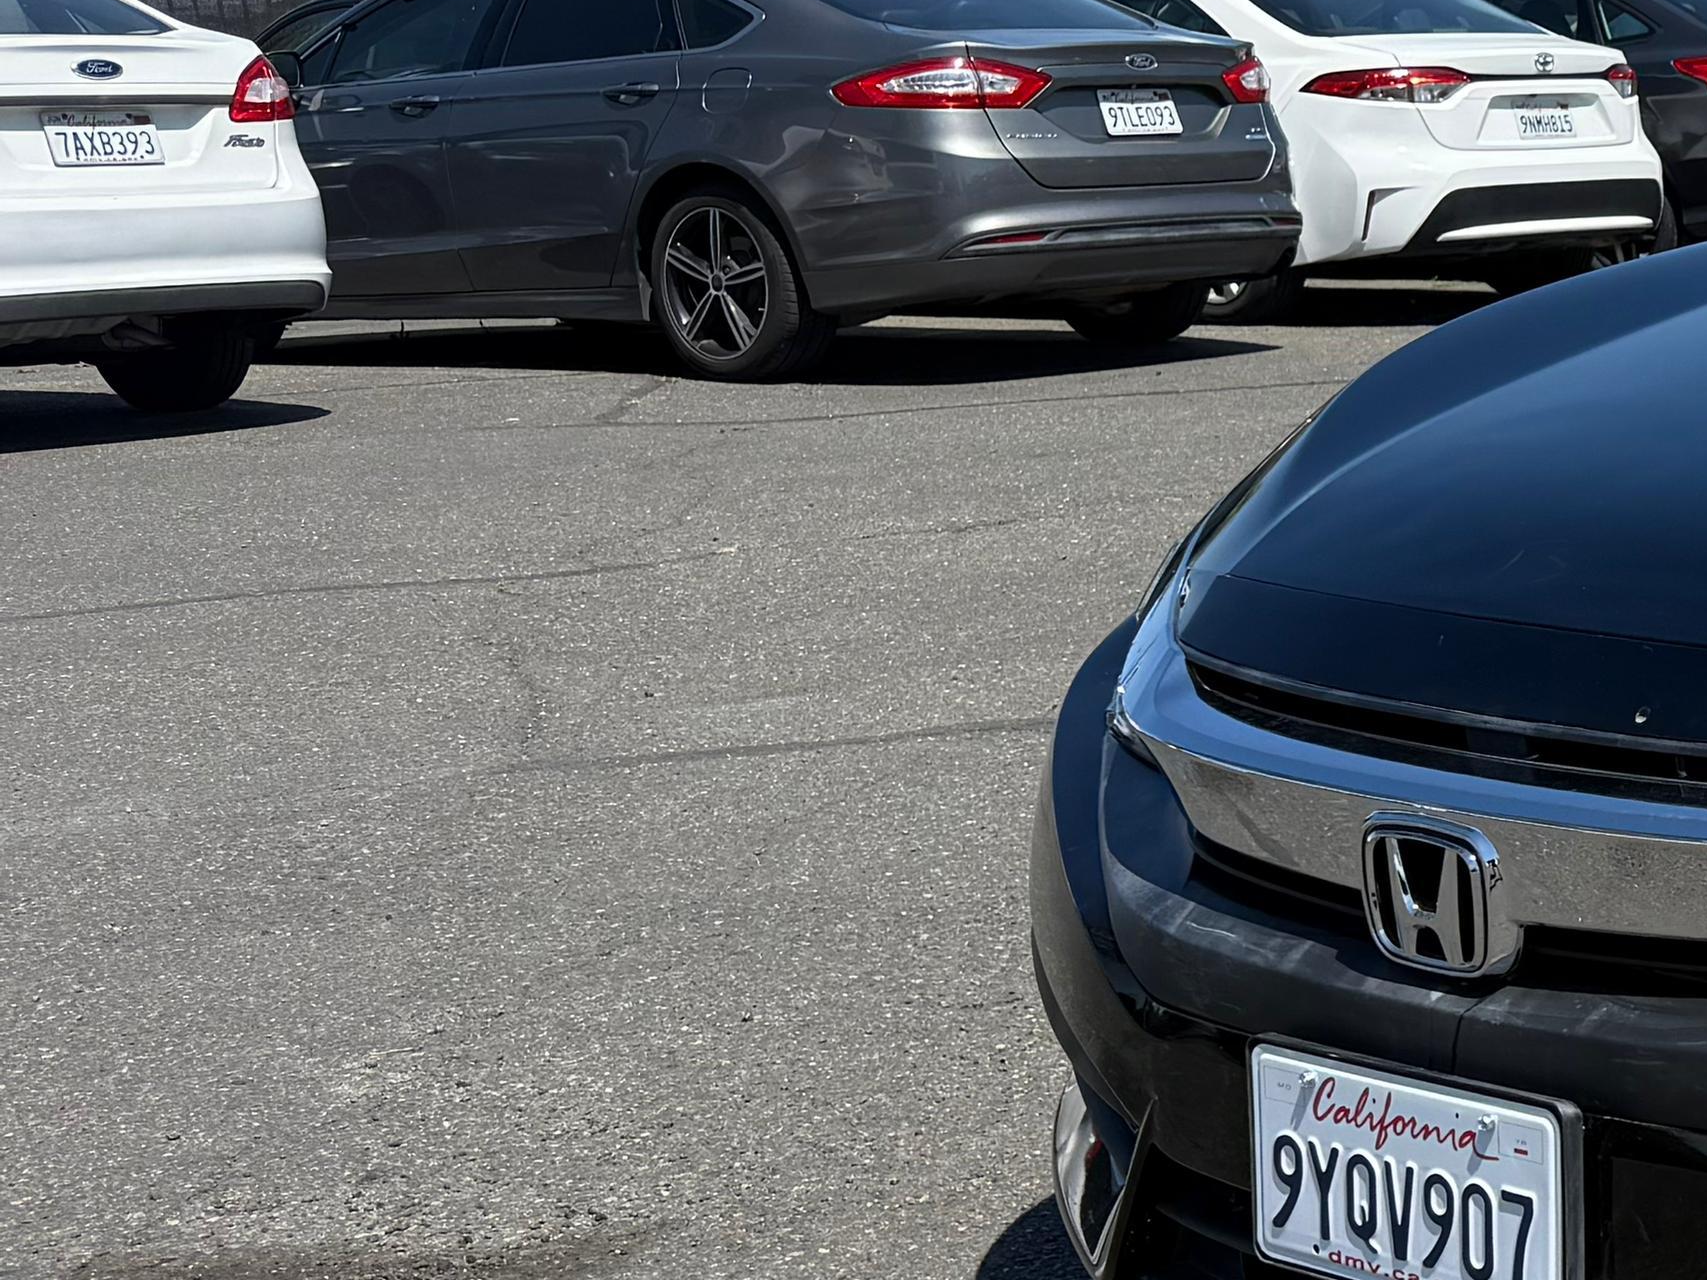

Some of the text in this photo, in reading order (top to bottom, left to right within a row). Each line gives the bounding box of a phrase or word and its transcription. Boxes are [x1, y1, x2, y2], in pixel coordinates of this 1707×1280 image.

[86, 61, 114, 74] Ford
[1108, 106, 1175, 128] 9TLE093
[54, 131, 155, 158] 7AXB393
[1312, 1076, 1500, 1161] California
